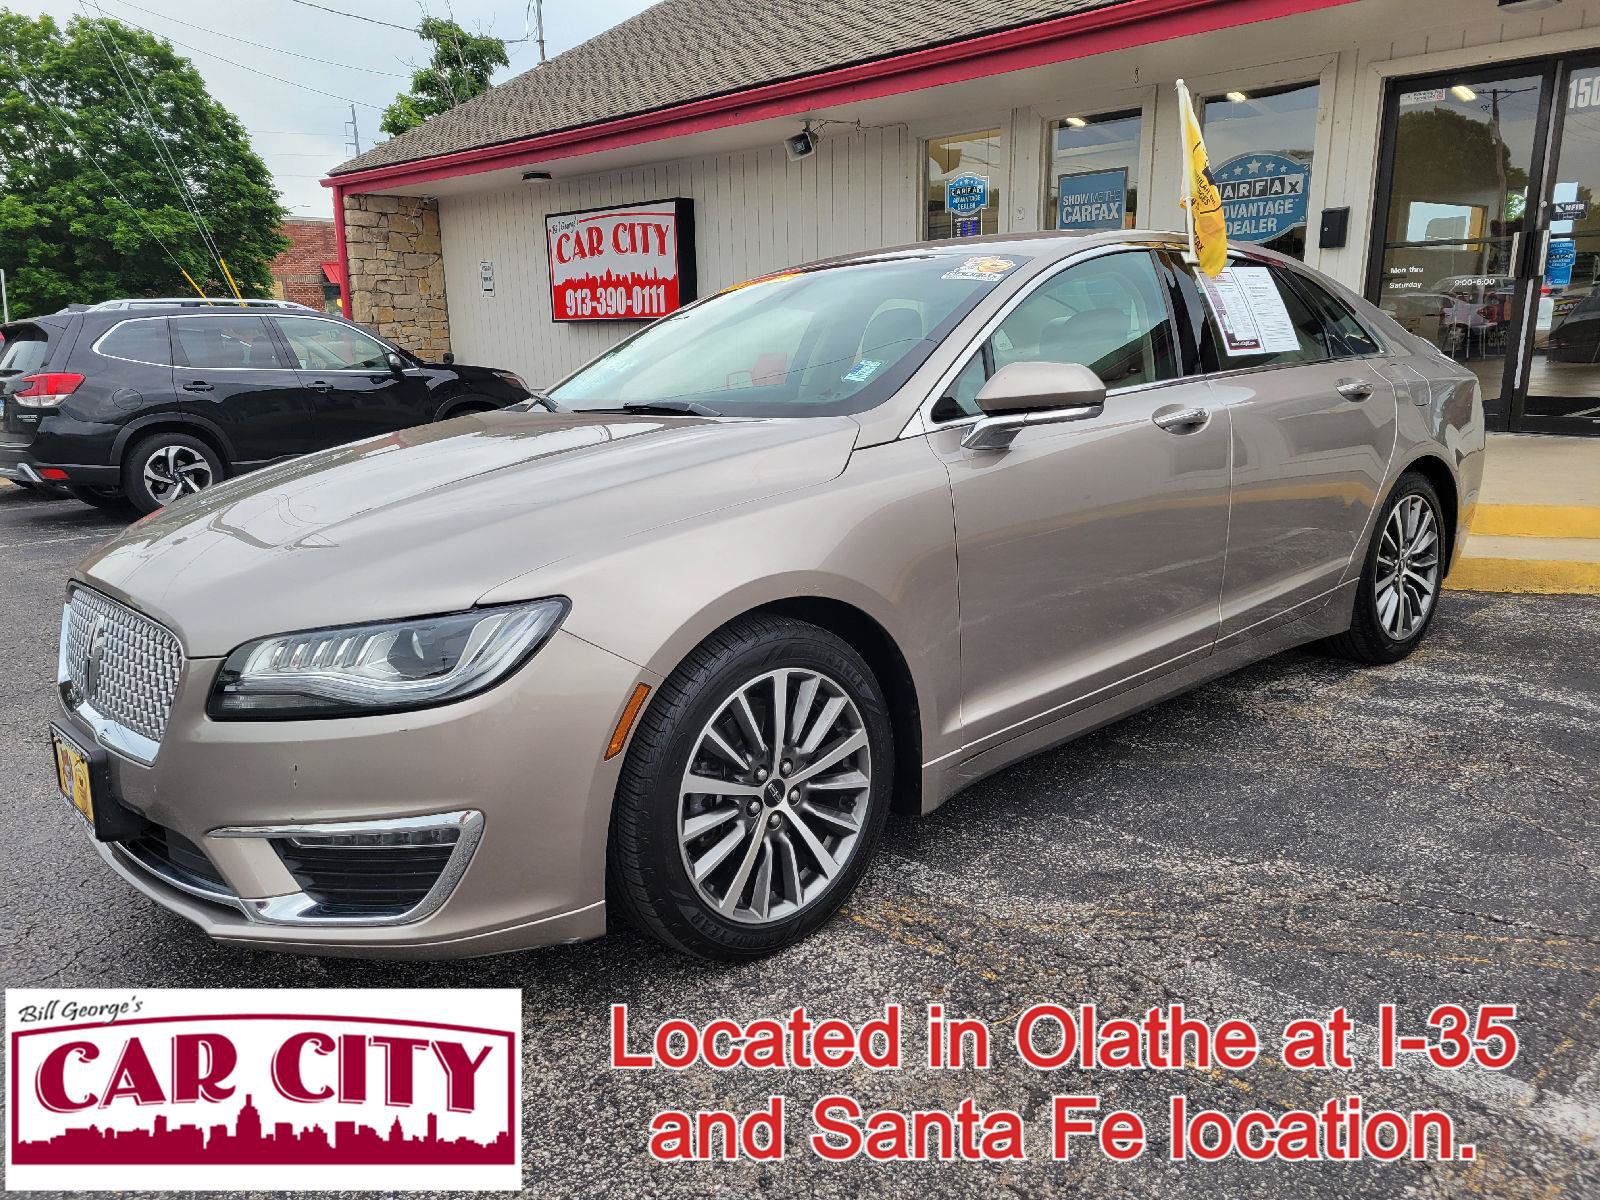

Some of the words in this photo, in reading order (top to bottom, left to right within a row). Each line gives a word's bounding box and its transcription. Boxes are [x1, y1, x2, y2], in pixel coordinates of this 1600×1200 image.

[1063, 193, 1087, 206] SHOW
[1090, 191, 1104, 203] ME
[1105, 189, 1121, 202] THE
[1222, 178, 1301, 199] ARFAX
[1063, 203, 1119, 224] CARFAX
[1222, 199, 1295, 218] DVANTAGE
[556, 226, 604, 264] CAR
[612, 222, 670, 256] CITY
[565, 285, 666, 317] 913-390-0111
